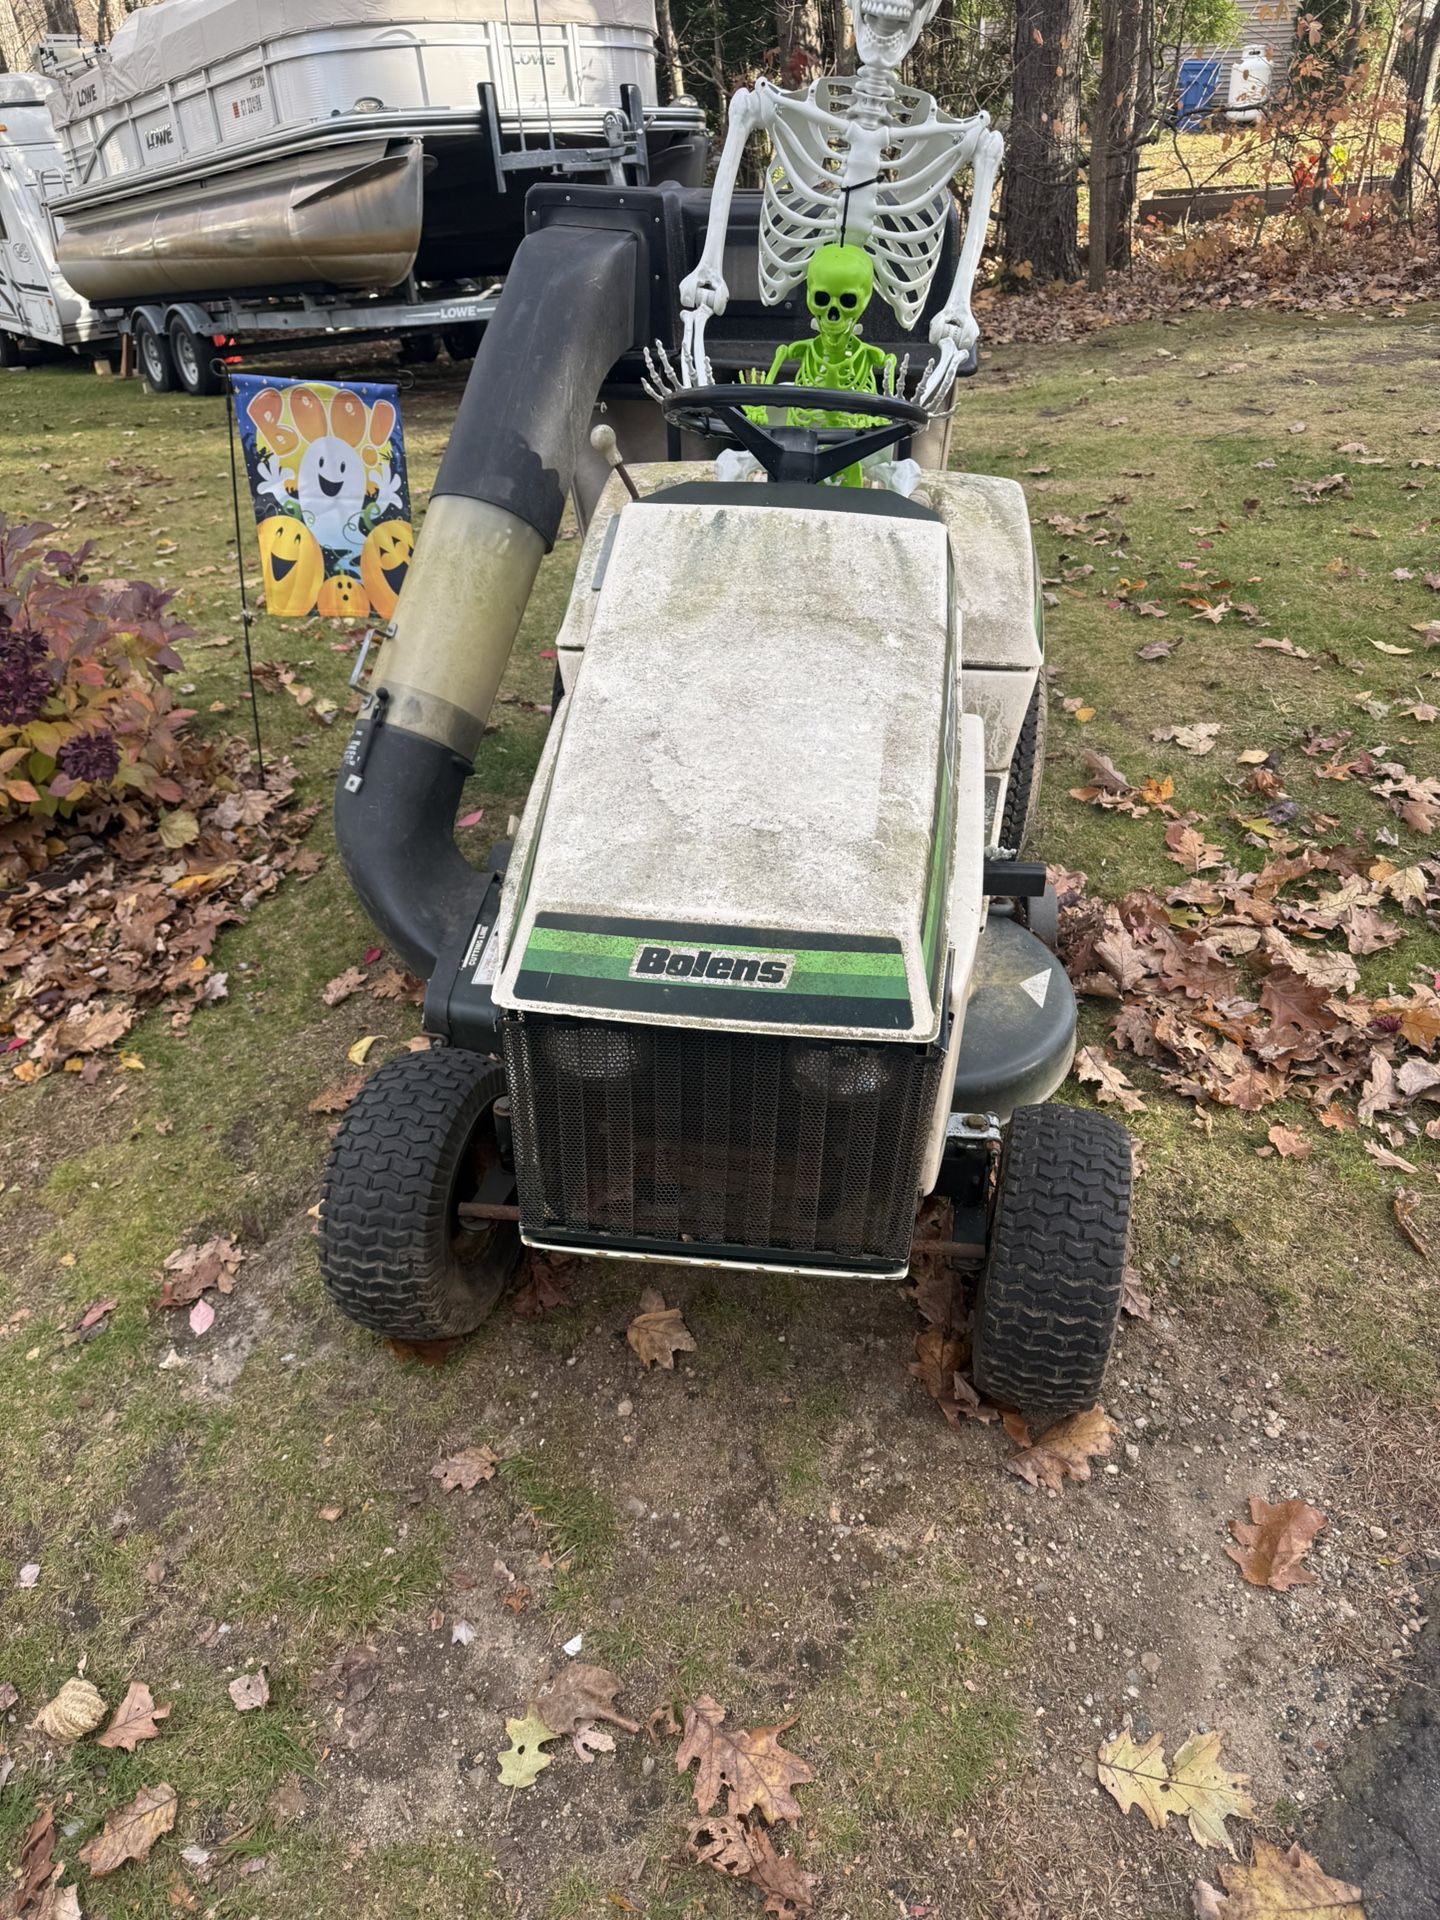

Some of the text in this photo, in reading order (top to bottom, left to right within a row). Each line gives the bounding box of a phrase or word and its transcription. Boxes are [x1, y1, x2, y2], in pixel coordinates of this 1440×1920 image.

[513, 53, 556, 65] LOWE
[77, 84, 97, 107] LOWE
[144, 124, 174, 150] LOWE
[440, 306, 476, 318] LOWE
[247, 387, 396, 467] BOO!
[468, 939, 483, 966] CUTTING
[636, 947, 786, 983] Bolens
